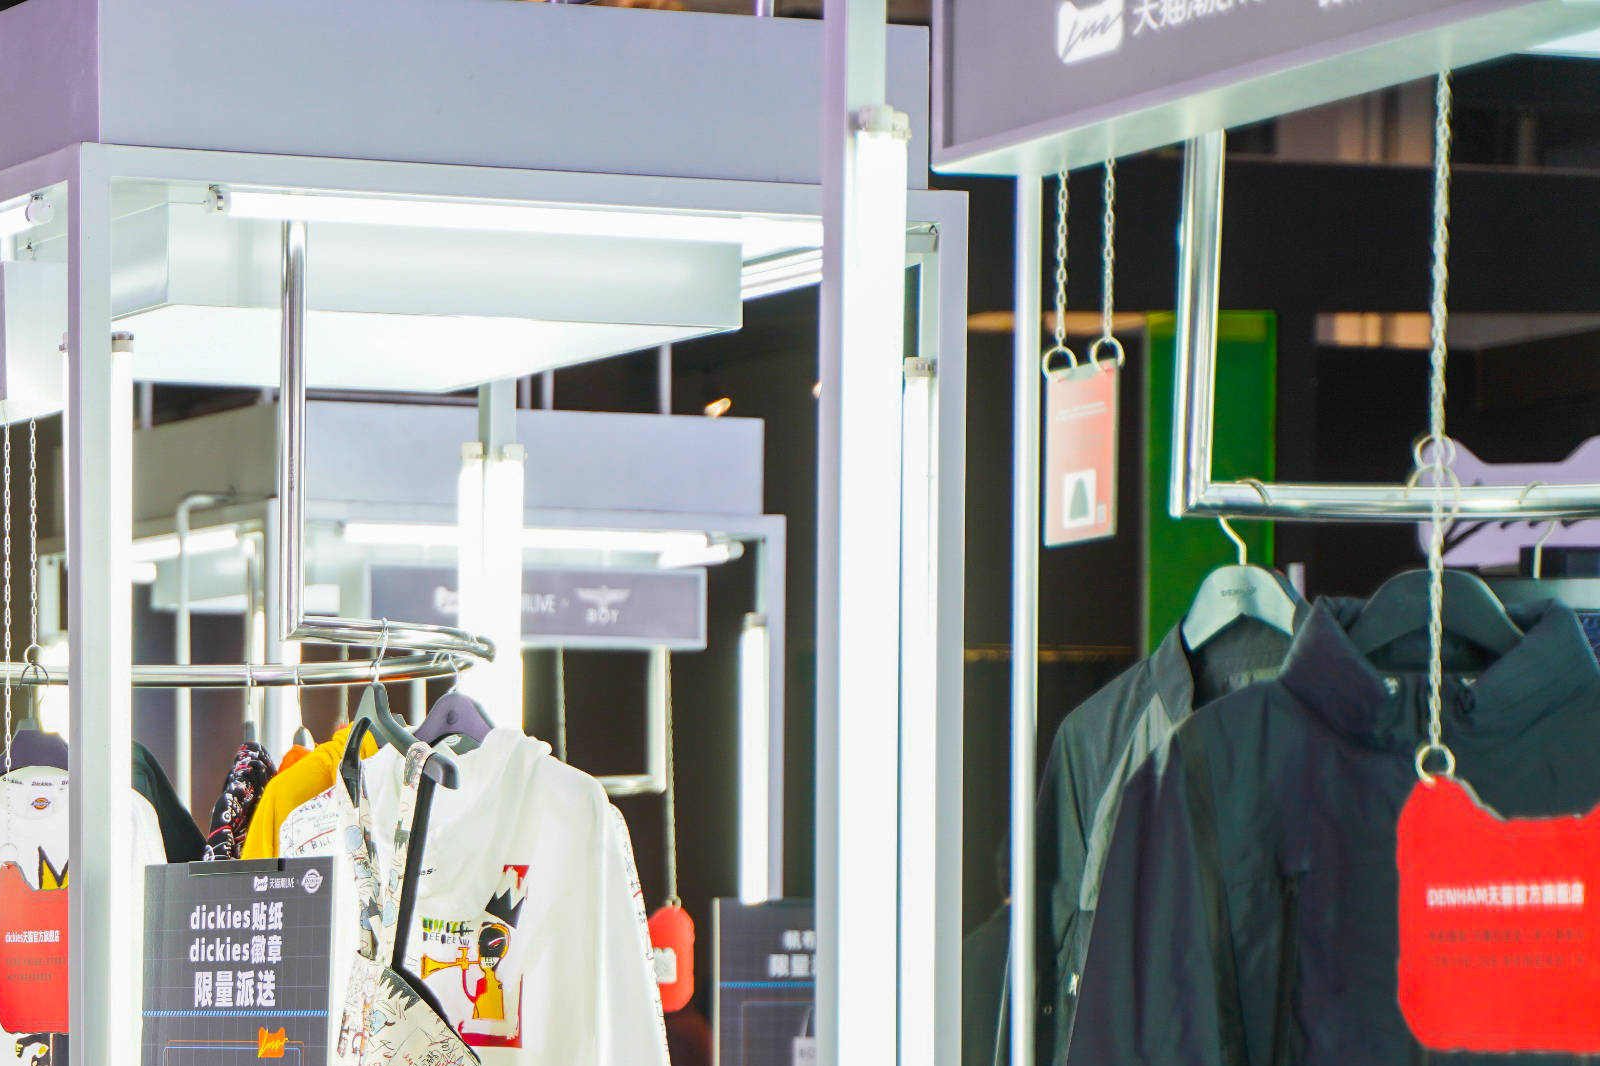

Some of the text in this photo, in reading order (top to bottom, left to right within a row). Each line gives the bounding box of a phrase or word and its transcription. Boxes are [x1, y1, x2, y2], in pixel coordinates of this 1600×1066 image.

[584, 607, 620, 625] BOY
[190, 902, 283, 930] dickies贴纸
[189, 935, 282, 964] dickies徽章
[194, 970, 276, 1008] 限量派送
